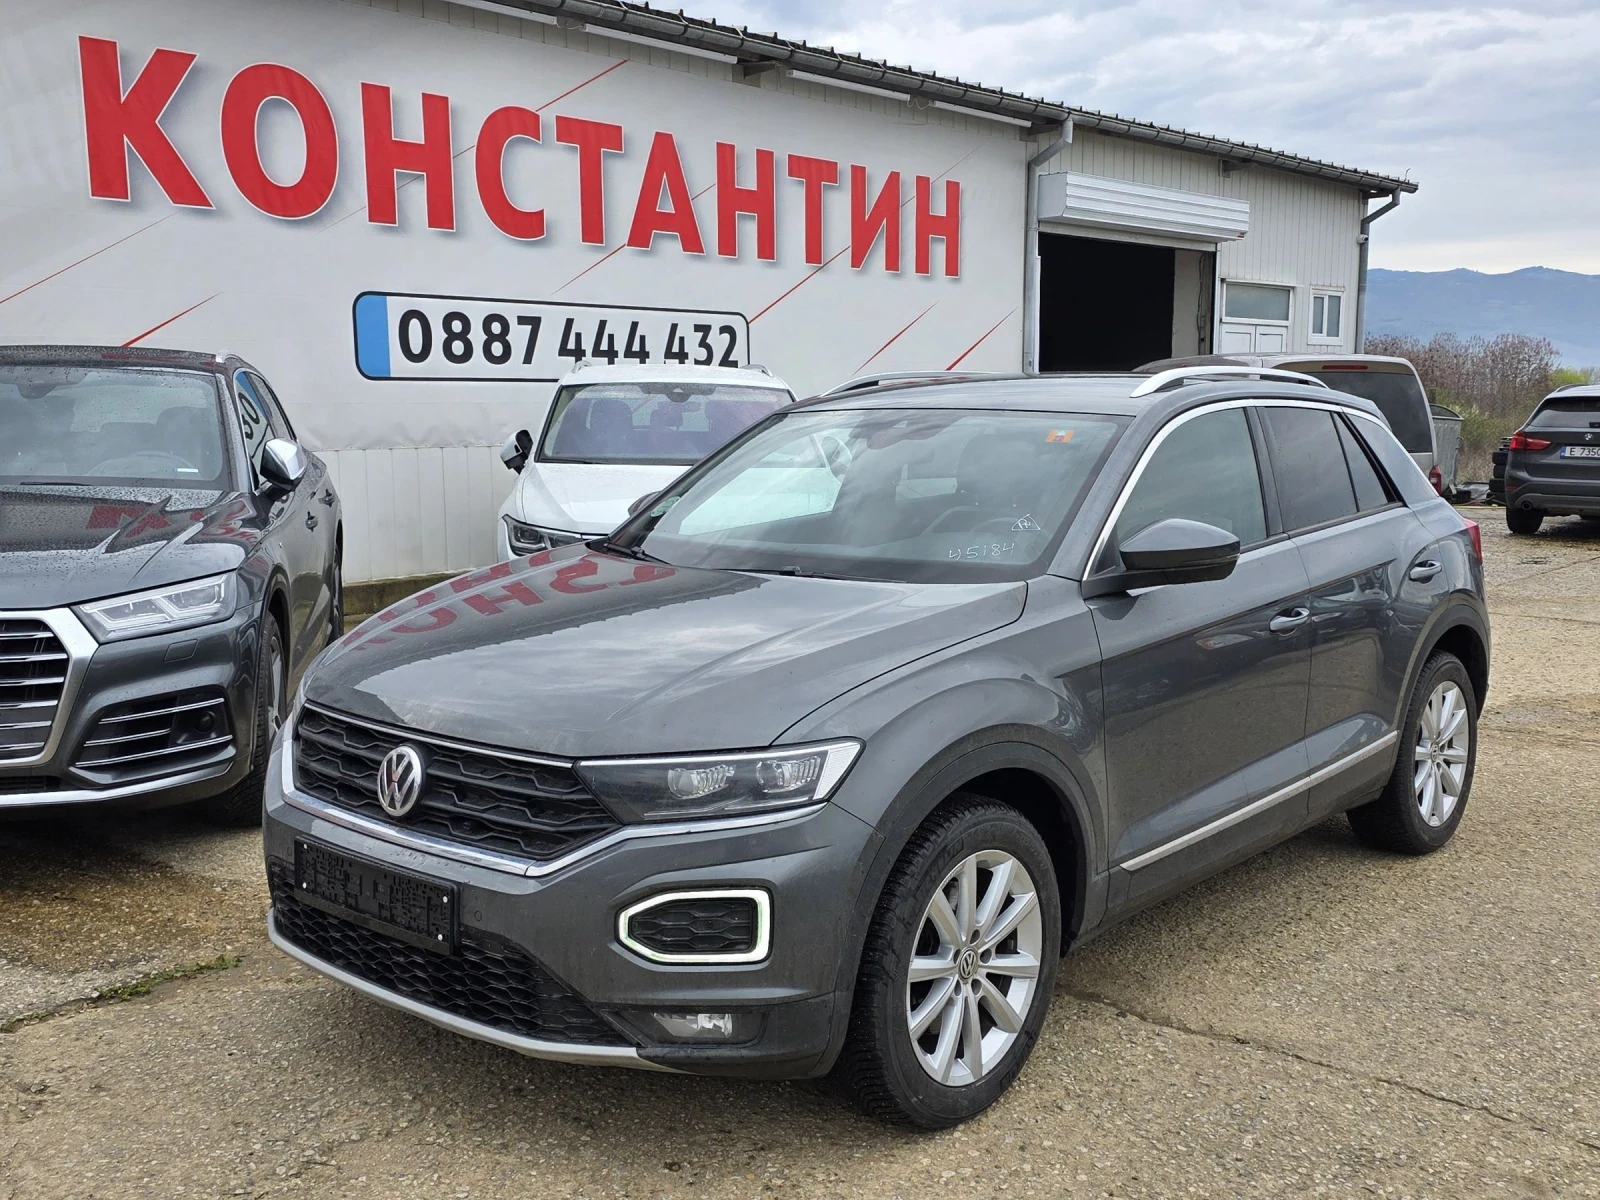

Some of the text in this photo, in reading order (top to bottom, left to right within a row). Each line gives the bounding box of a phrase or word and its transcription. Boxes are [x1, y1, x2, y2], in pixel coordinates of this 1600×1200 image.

[78, 35, 961, 279] КОНСТАНТИН
[398, 308, 739, 368] 0887 444 432
[1569, 447, 1576, 456] E
